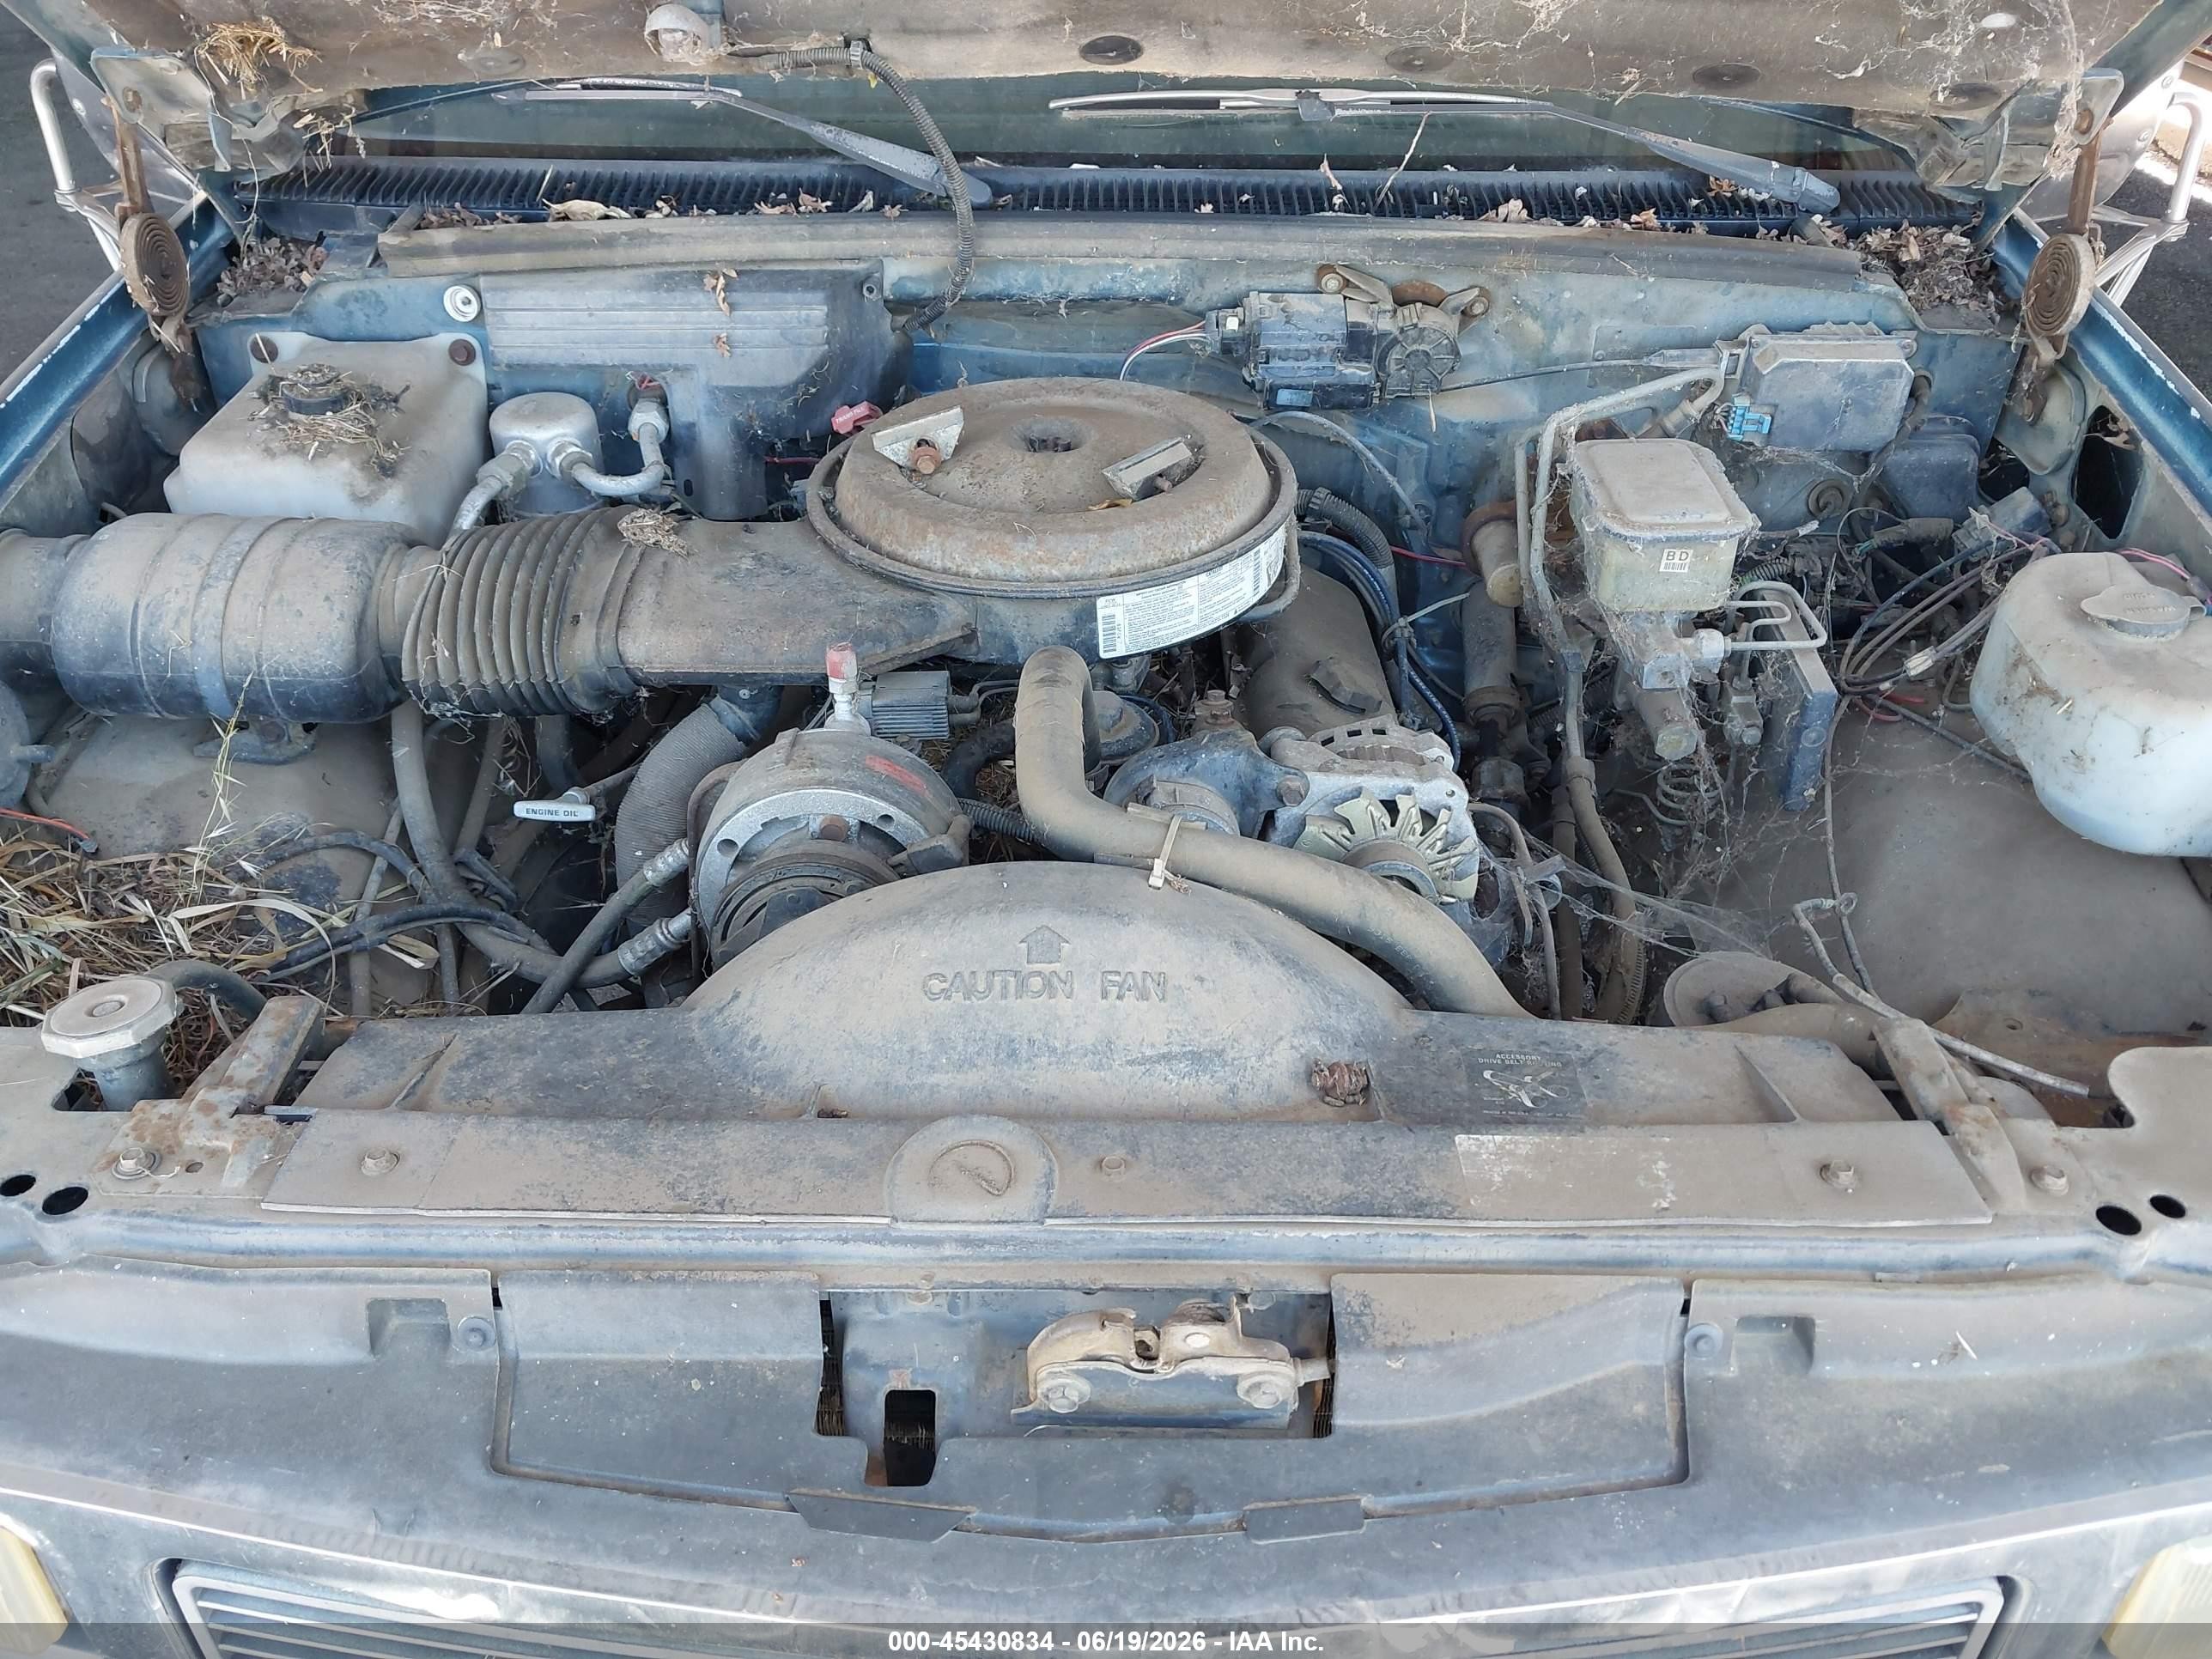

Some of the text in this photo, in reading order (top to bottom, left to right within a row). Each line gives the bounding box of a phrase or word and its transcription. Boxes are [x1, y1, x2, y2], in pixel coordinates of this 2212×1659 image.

[526, 807, 560, 817] ENGINE
[922, 970, 1166, 1002] CAUTION FAN
